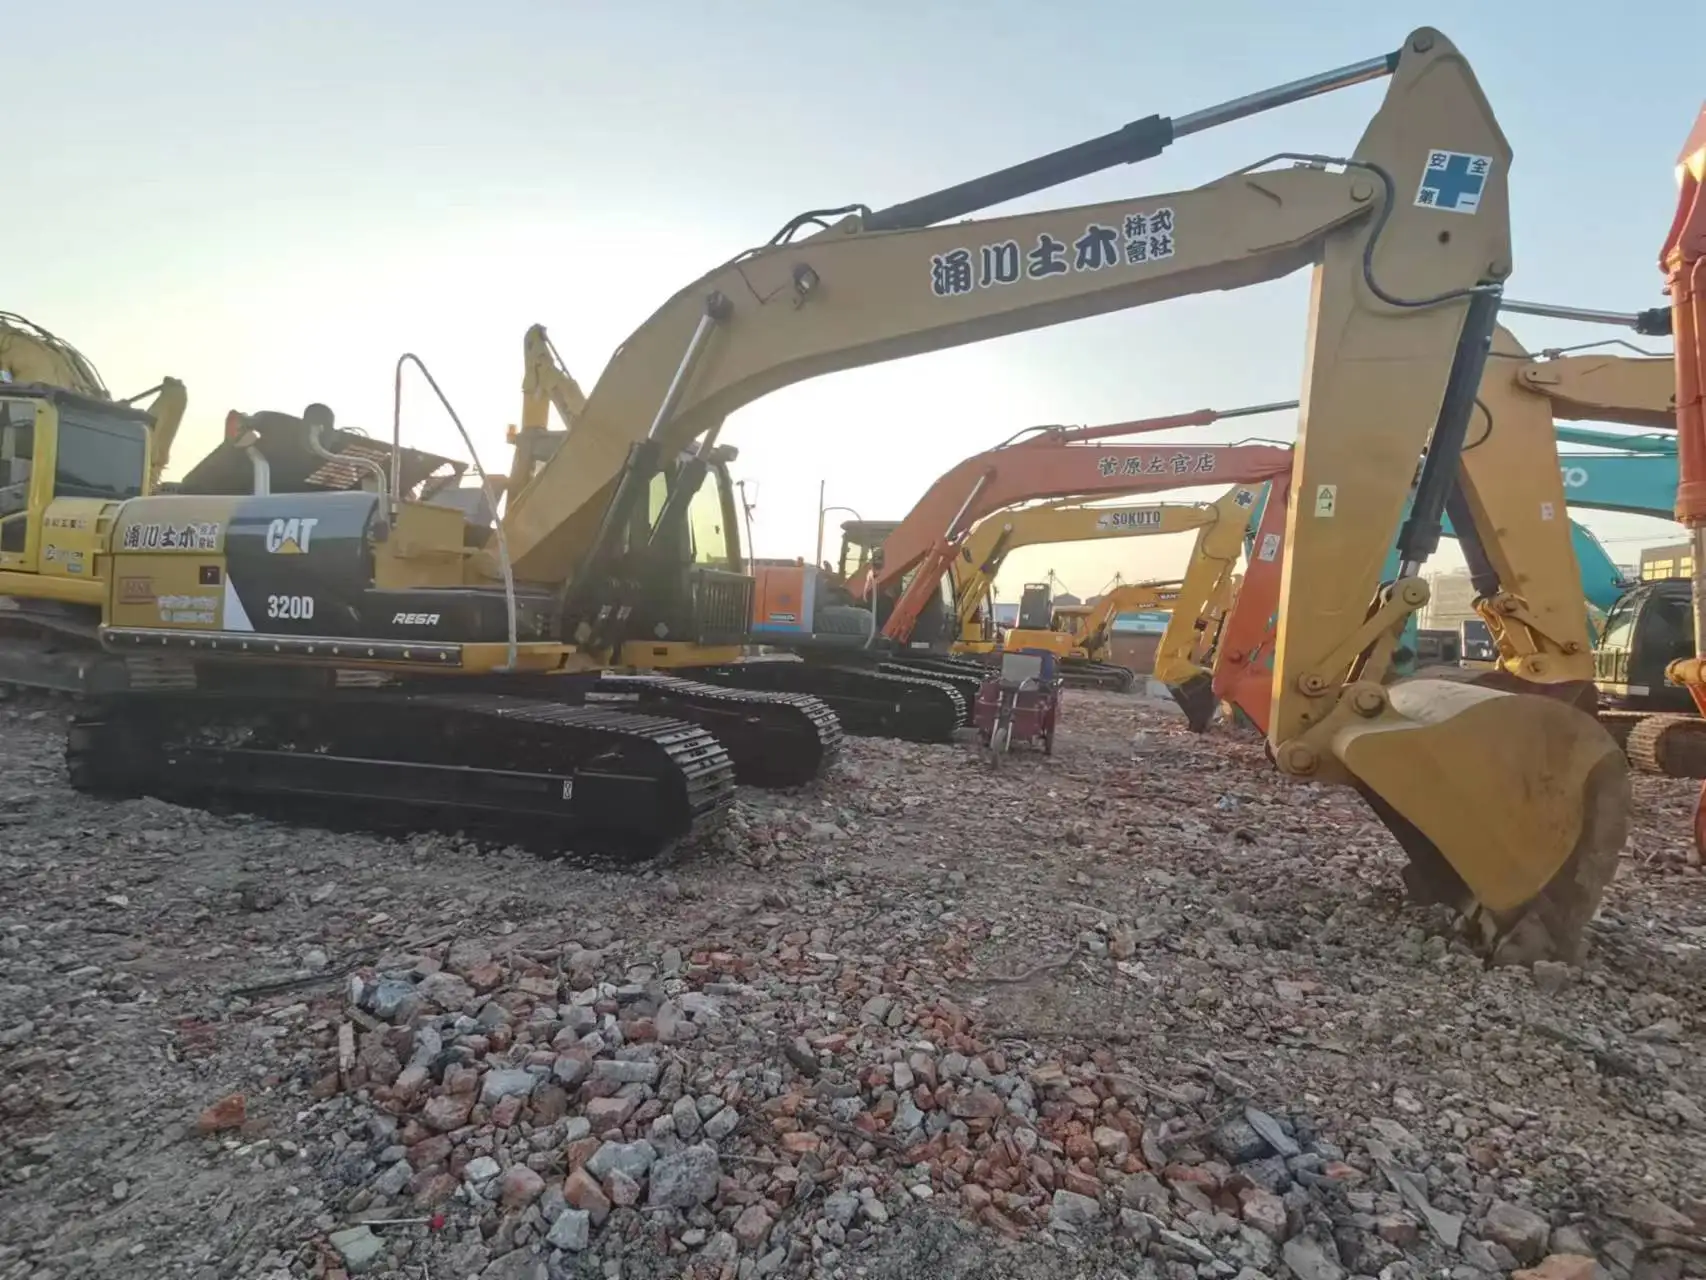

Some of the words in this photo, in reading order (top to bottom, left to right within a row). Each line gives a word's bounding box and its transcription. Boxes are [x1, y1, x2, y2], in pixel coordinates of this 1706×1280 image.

[1112, 510, 1161, 526] SOKUTO
[266, 518, 319, 554] CAT
[267, 595, 315, 619] 320D
